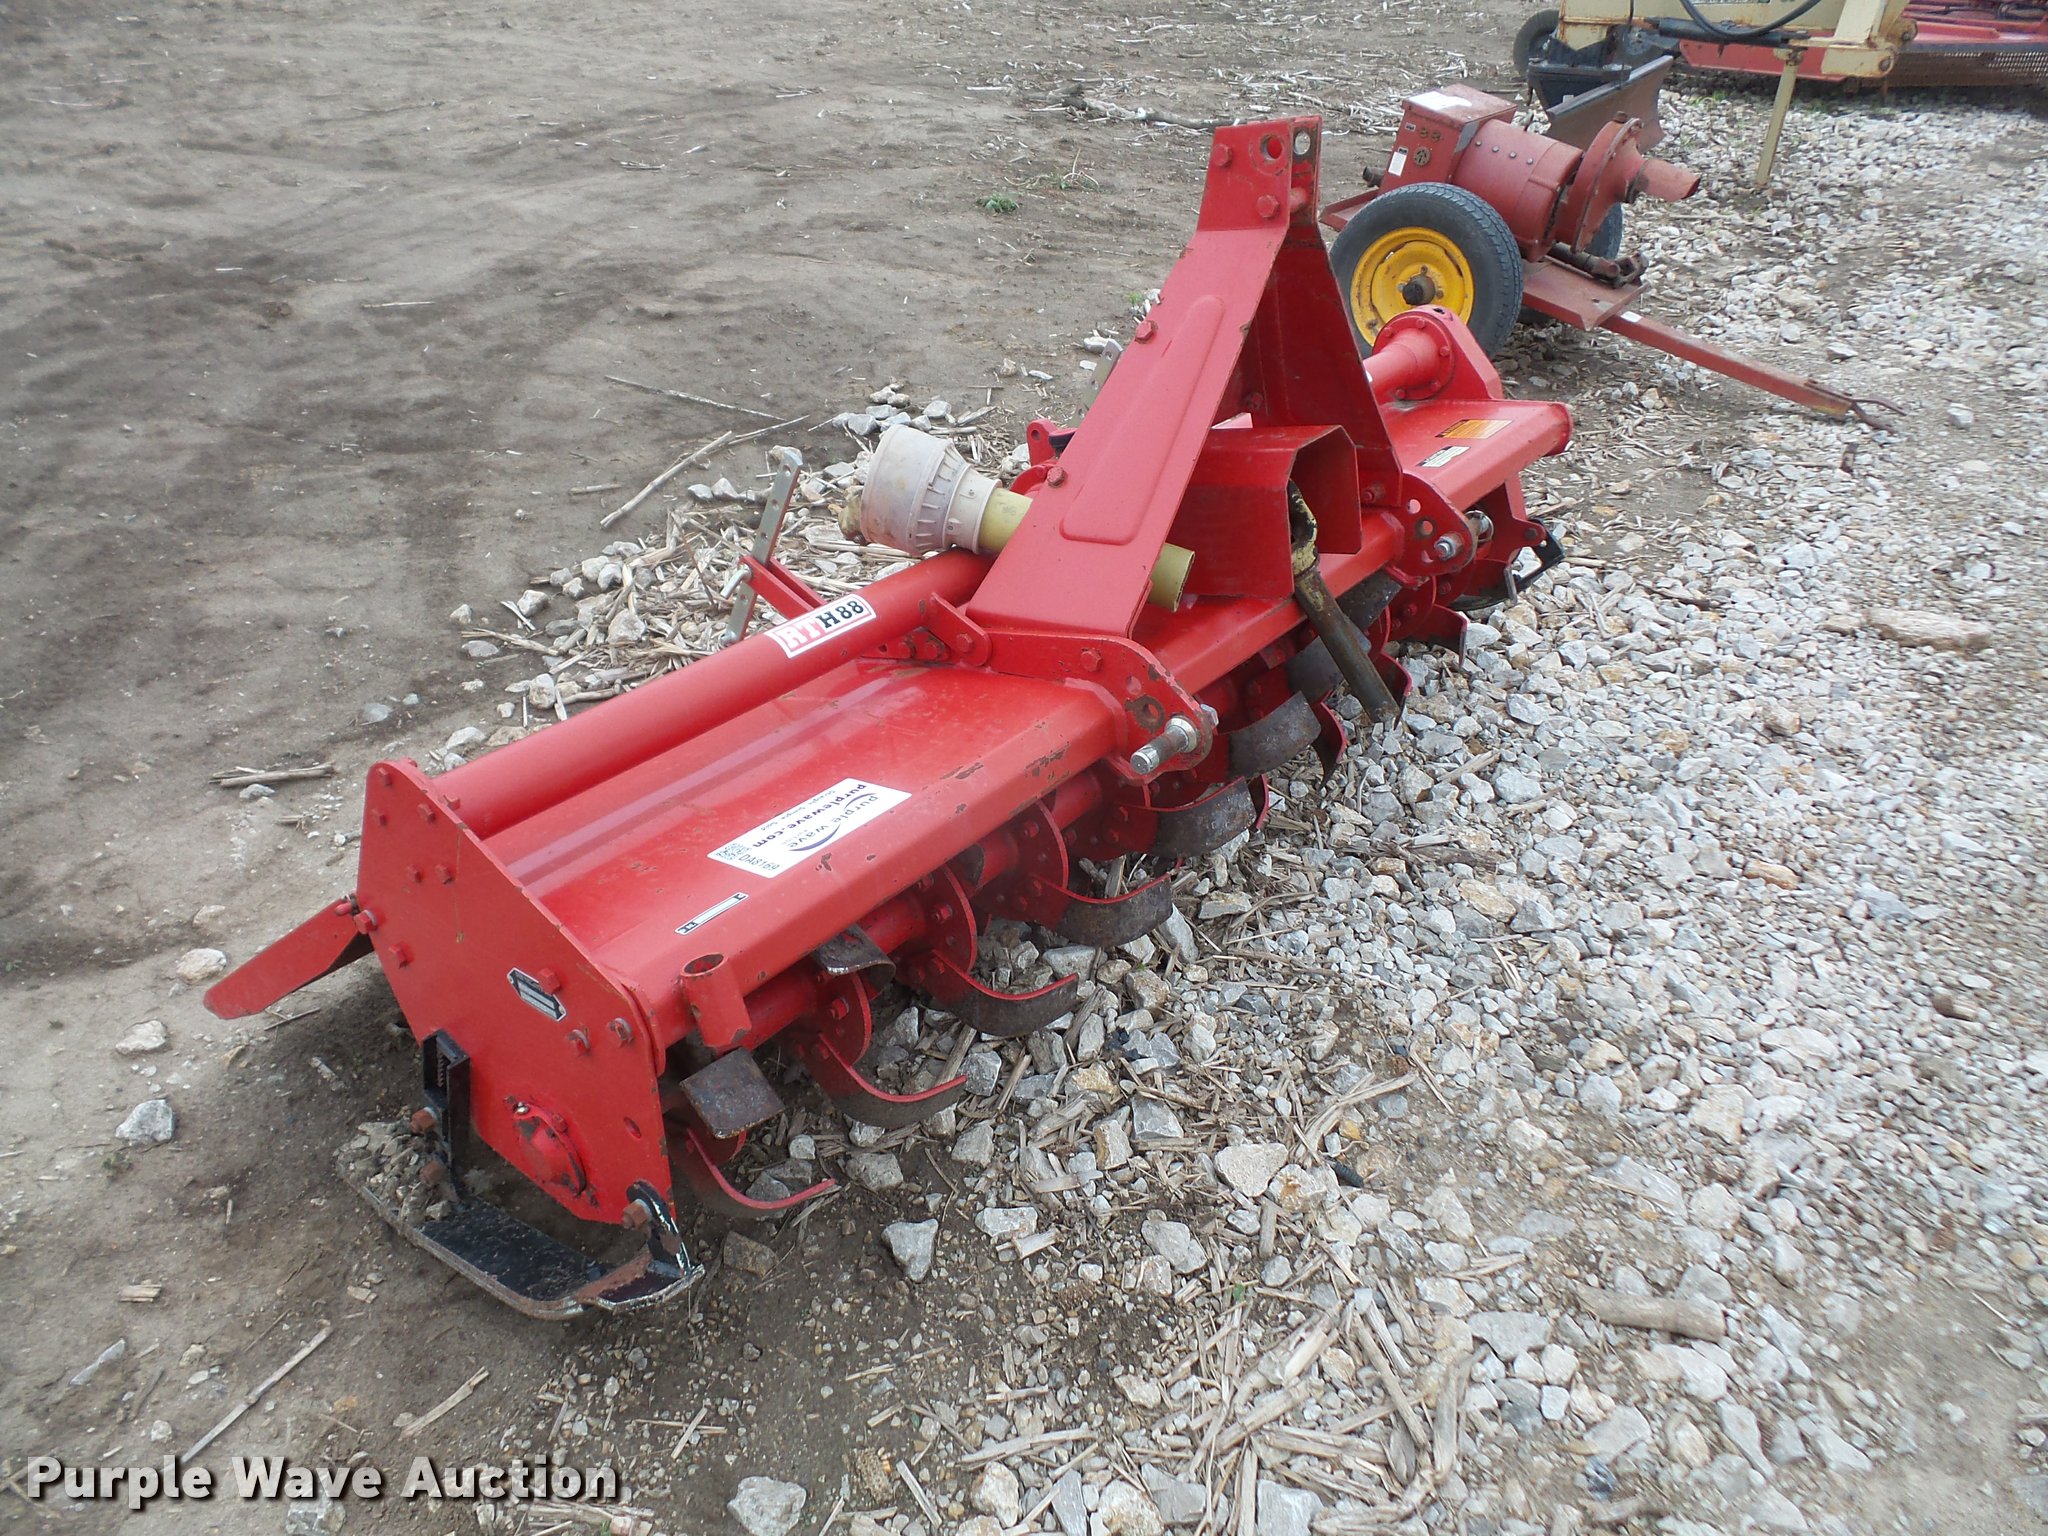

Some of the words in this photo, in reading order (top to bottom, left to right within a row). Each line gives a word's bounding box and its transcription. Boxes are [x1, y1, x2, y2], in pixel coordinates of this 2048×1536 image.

[752, 783, 867, 848] purplewave.com
[831, 795, 879, 823] purple
[787, 825, 830, 848] wave
